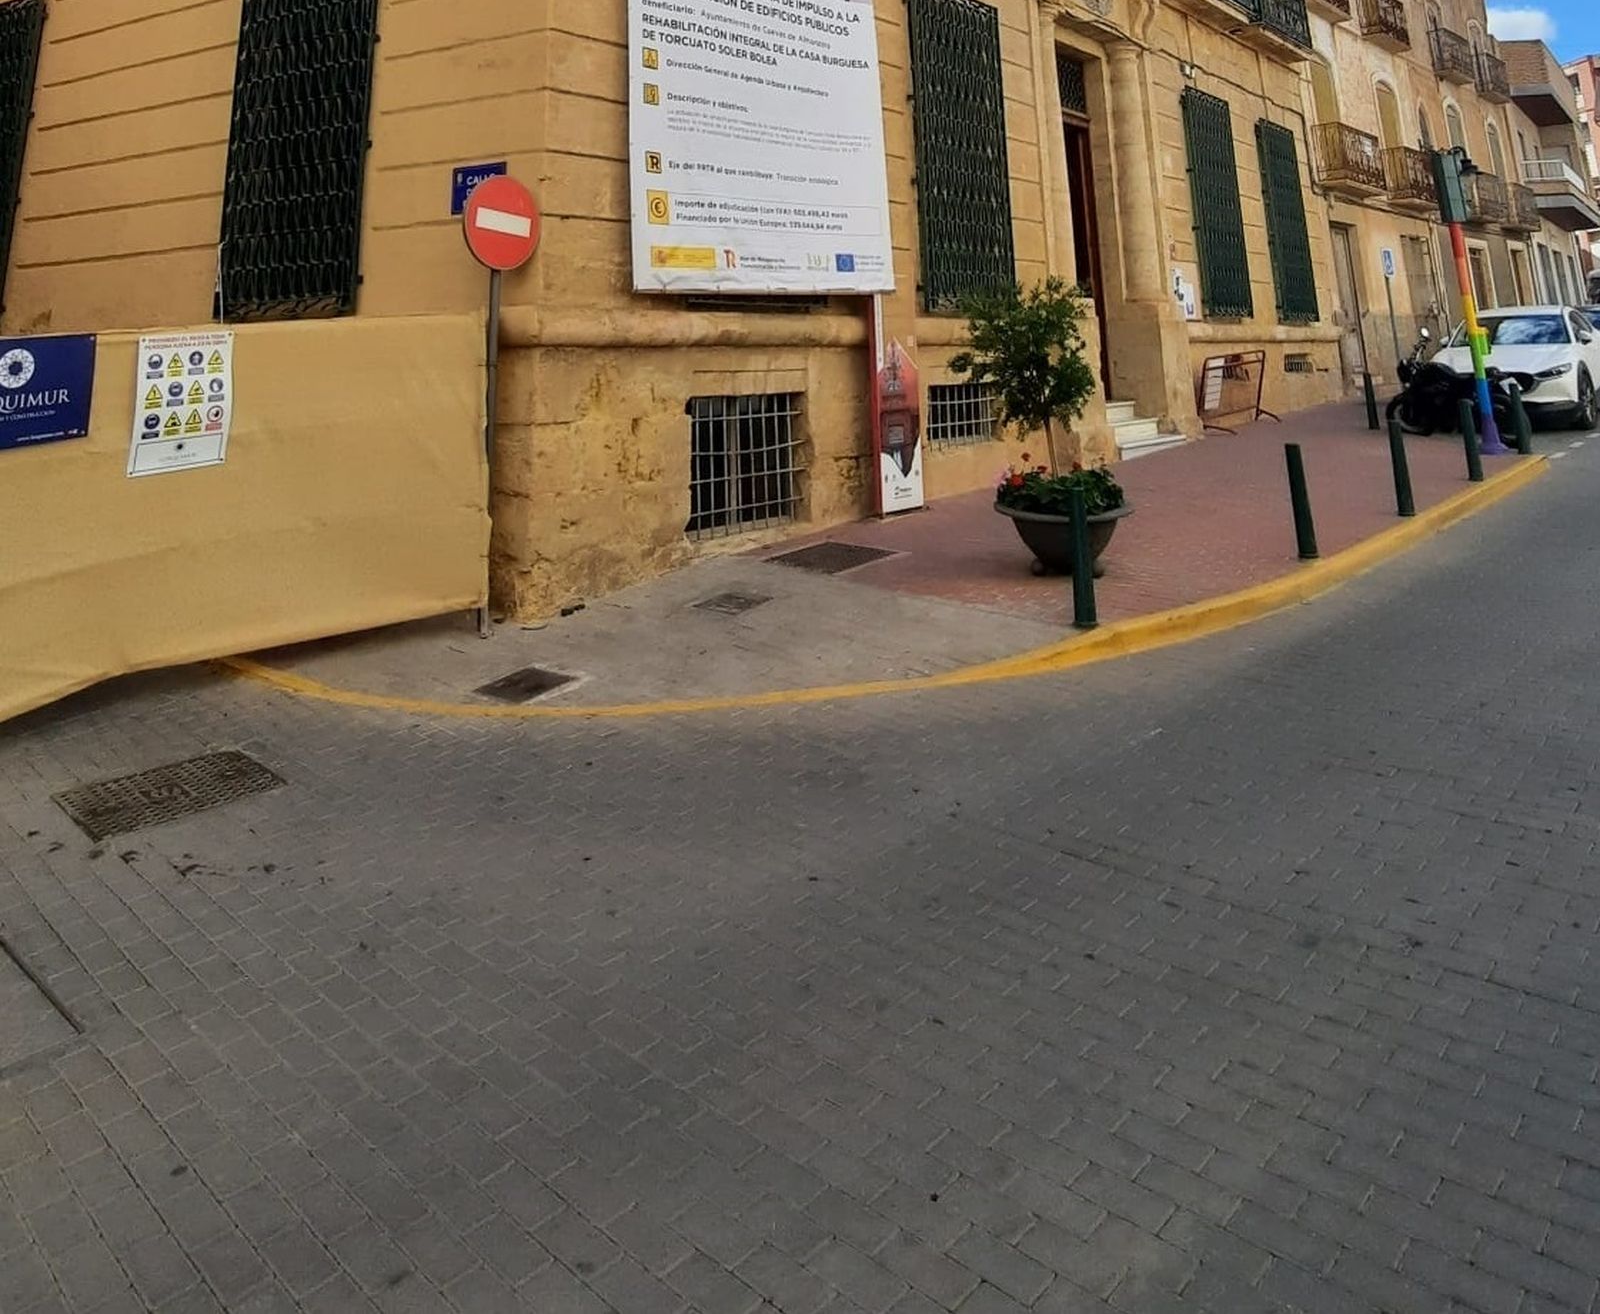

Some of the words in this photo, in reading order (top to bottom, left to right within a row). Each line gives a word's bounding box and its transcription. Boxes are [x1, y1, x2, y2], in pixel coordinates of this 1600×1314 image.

[740, 0, 755, 13] DE
[756, 3, 803, 26] EDIFICIOS
[796, 0, 835, 19] IMPULSO
[836, 11, 844, 21] A
[845, 12, 860, 24] LA
[642, 28, 656, 41] DE
[658, 31, 717, 52] TORCUATO
[718, 44, 748, 59] SOLER
[749, 51, 778, 66] BOLEA
[729, 32, 772, 52] INTEGRAL
[773, 43, 785, 55] DE
[786, 46, 797, 57] LA
[798, 49, 821, 62] CASA
[822, 54, 870, 69] BURGUESA
